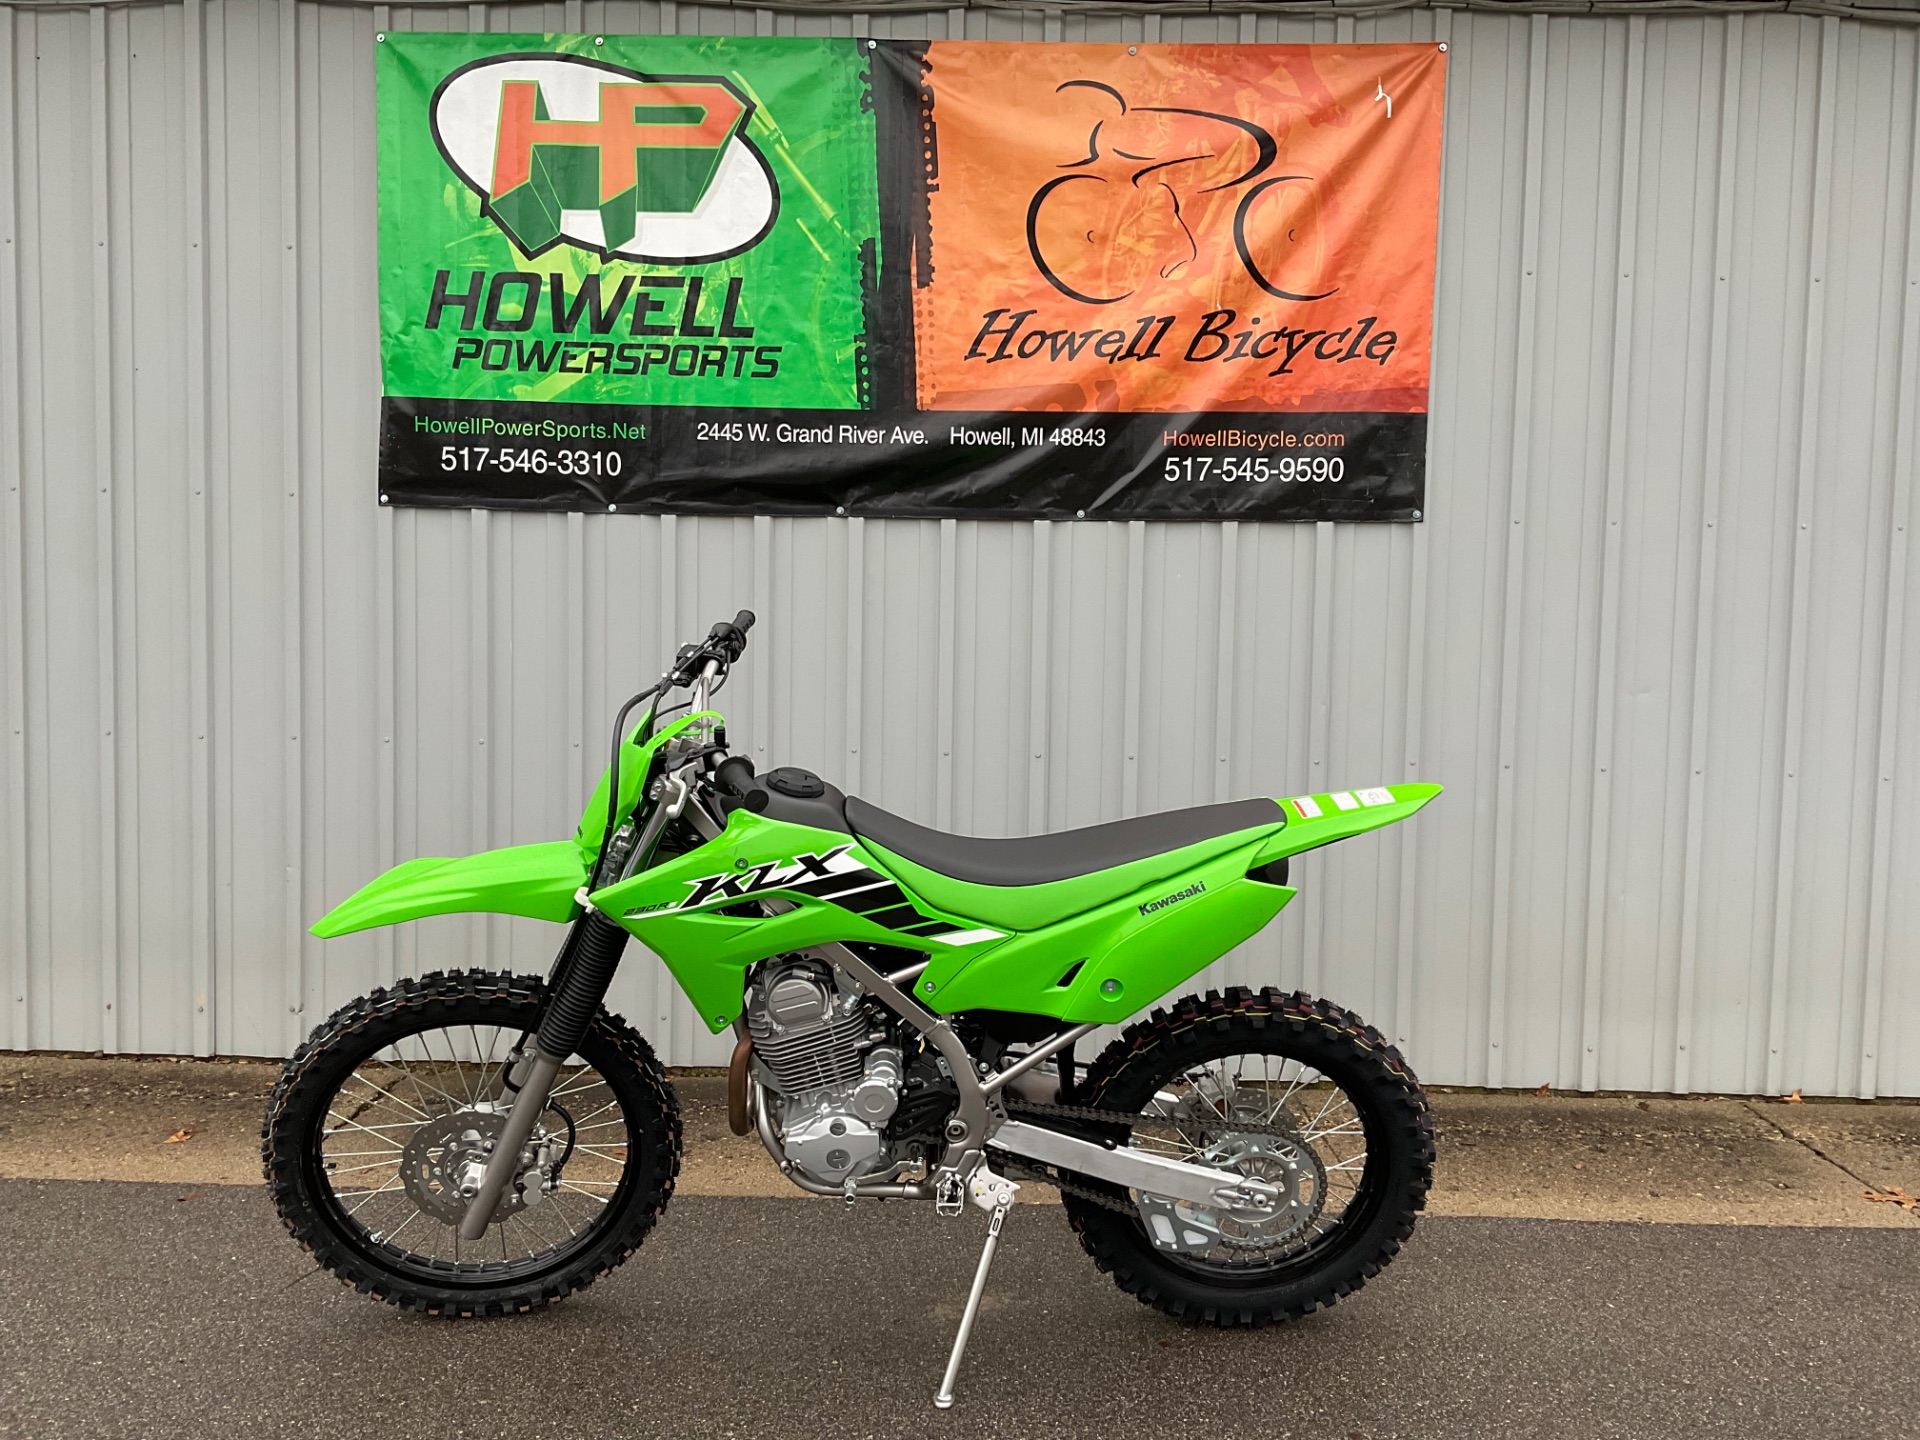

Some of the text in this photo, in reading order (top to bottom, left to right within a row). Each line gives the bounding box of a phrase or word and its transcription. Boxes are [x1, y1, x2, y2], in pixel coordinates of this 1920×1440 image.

[490, 80, 748, 252] HP
[424, 269, 755, 338] HOWELL
[452, 337, 783, 379] POWERSPORTS
[963, 307, 1398, 378] Howell Bicycle
[414, 415, 647, 442] HowellPowerSports.Net
[696, 422, 1106, 449] 2445 W. Grand River Ave. Howell, MI 48843
[1163, 429, 1345, 451] HowellBicycle.com
[441, 446, 622, 477] 517-546-3310
[1164, 456, 1345, 483] 517-545-9590
[679, 843, 856, 909] KLX
[1138, 881, 1206, 916] Kawasaki
